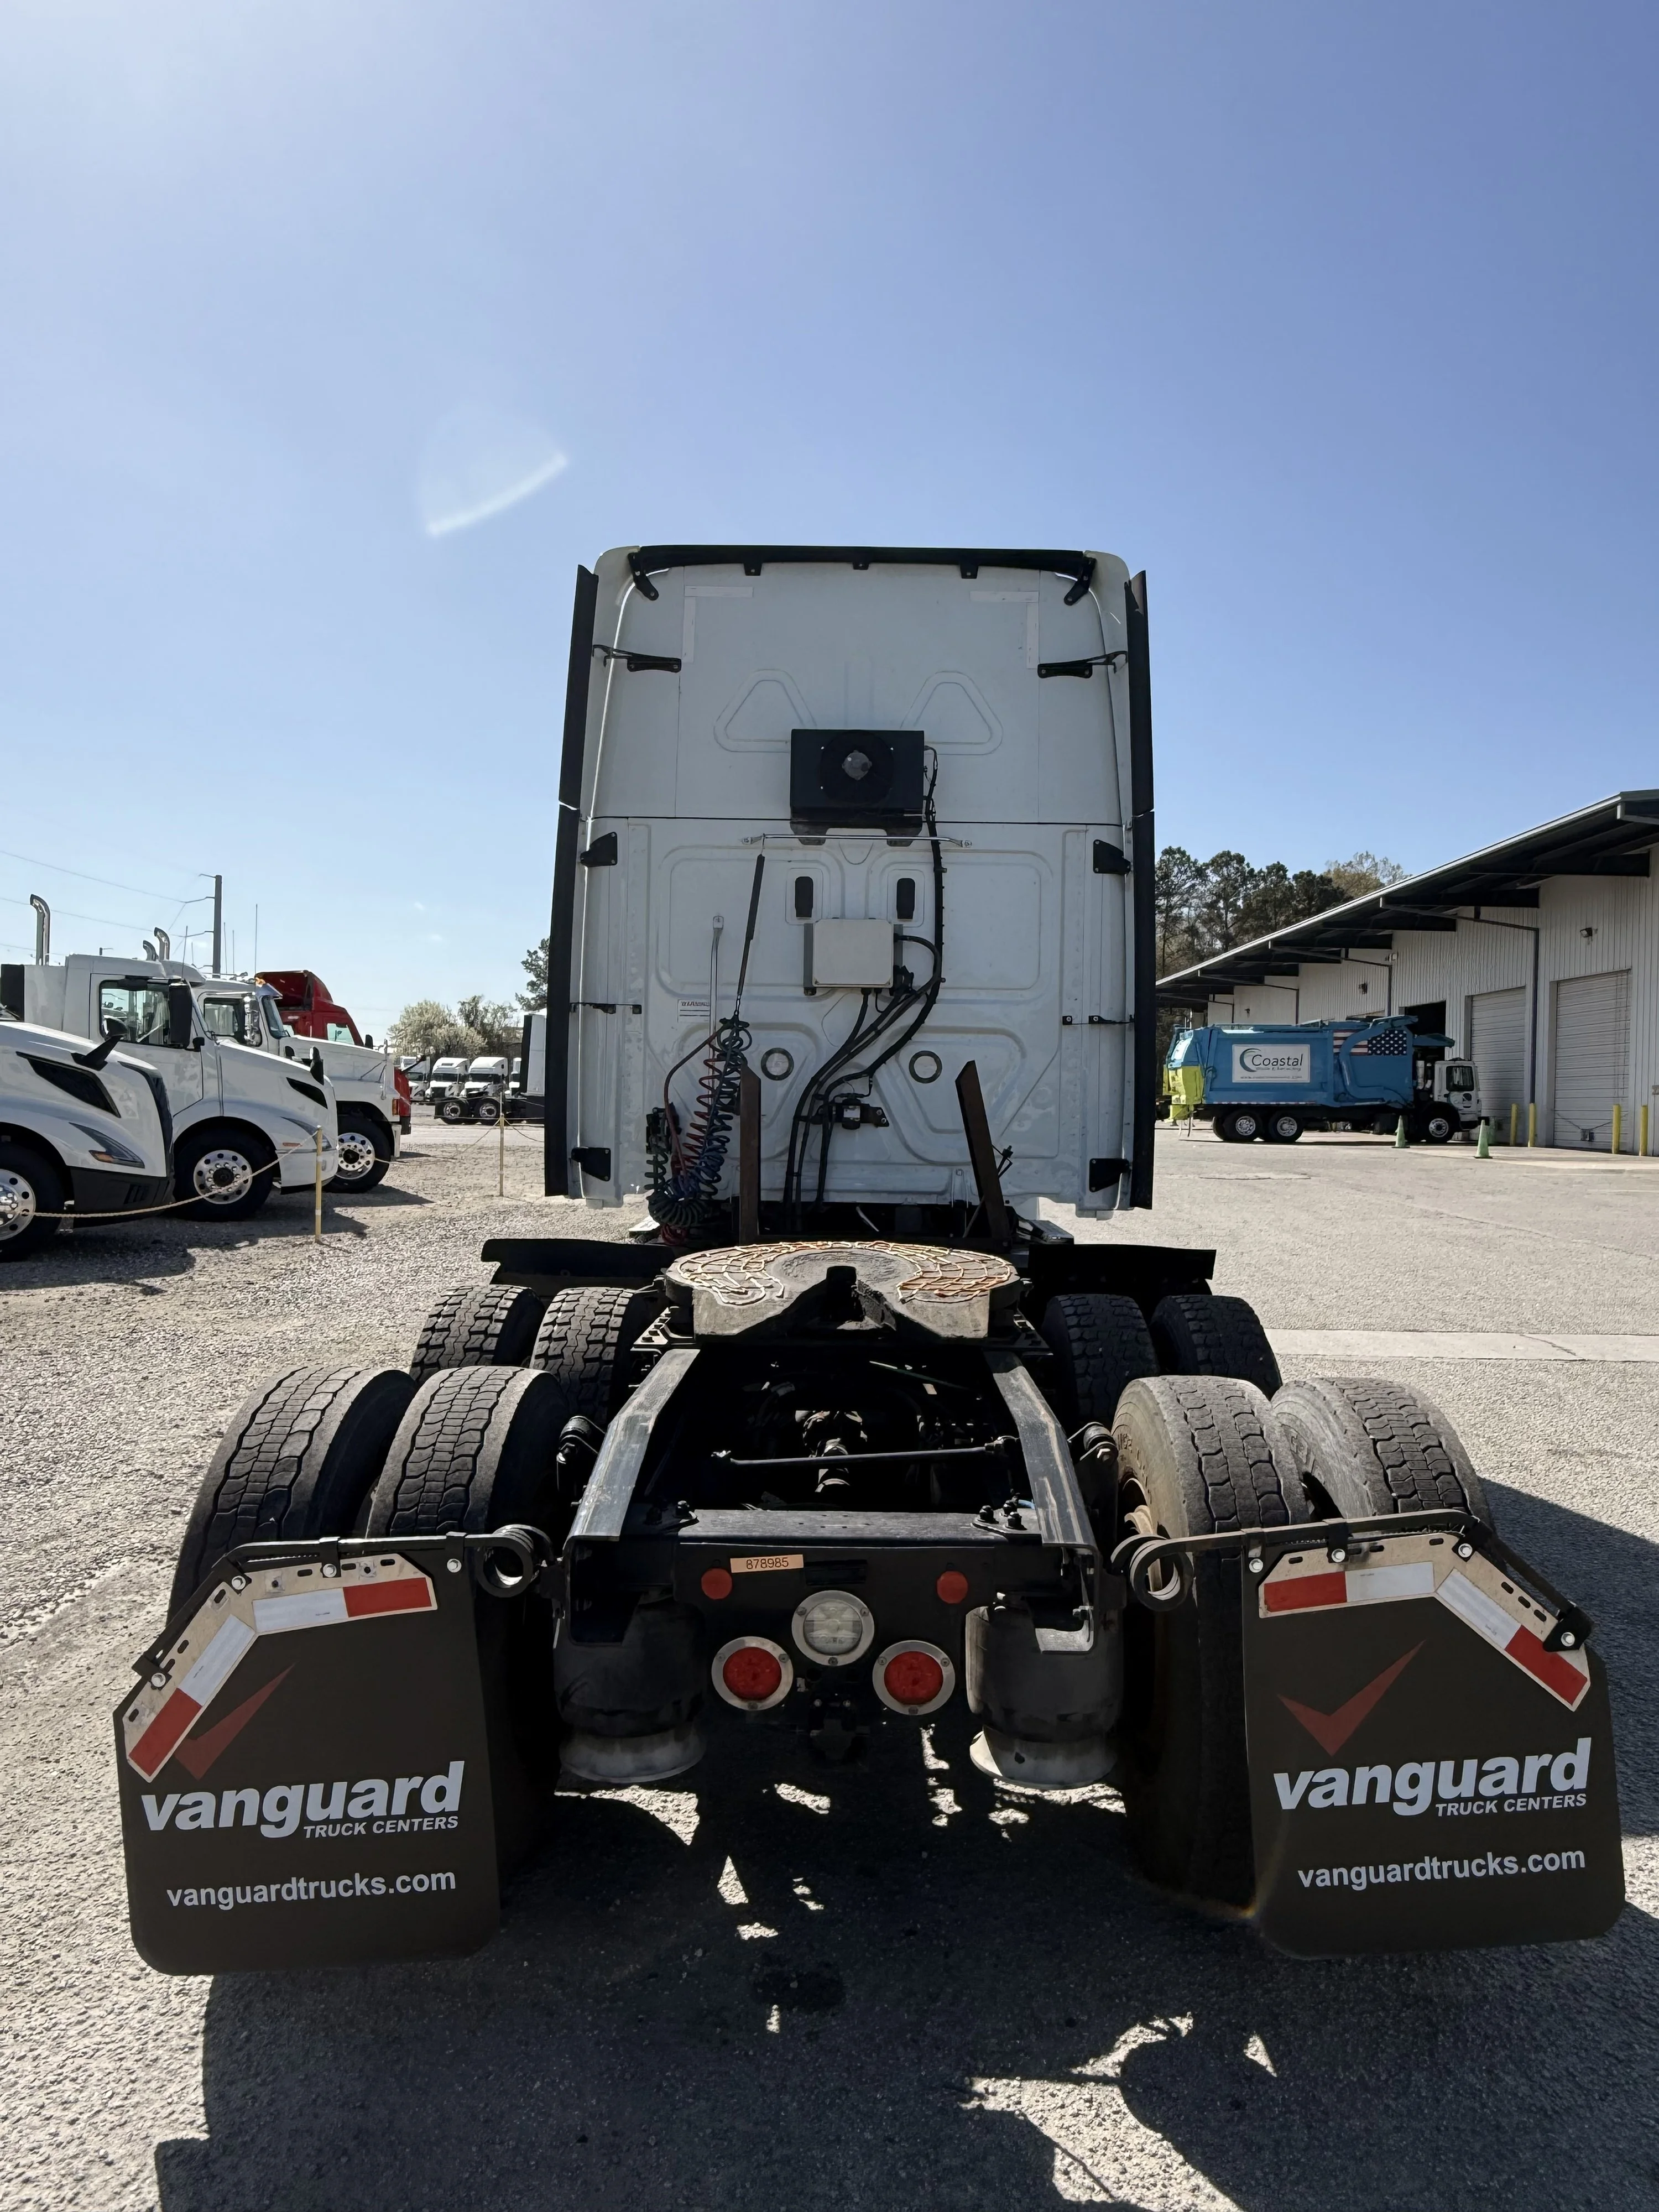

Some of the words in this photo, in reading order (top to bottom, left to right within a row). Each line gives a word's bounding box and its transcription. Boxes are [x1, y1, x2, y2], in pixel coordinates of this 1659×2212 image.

[1251, 1053, 1303, 1066] Coastal
[746, 1557, 789, 1569] 878985
[1273, 1737, 1592, 1817] vanguard
[141, 1761, 465, 1839] vanguard
[1436, 1800, 1498, 1817] TRUCK
[1504, 1793, 1587, 1812] CENTERS
[304, 1822, 367, 1839] TRUCK
[372, 1816, 459, 1835] CENTERS
[1297, 1850, 1586, 1891] vanguardtrucks.com
[166, 1871, 456, 1911] vanguardtrucks.com
